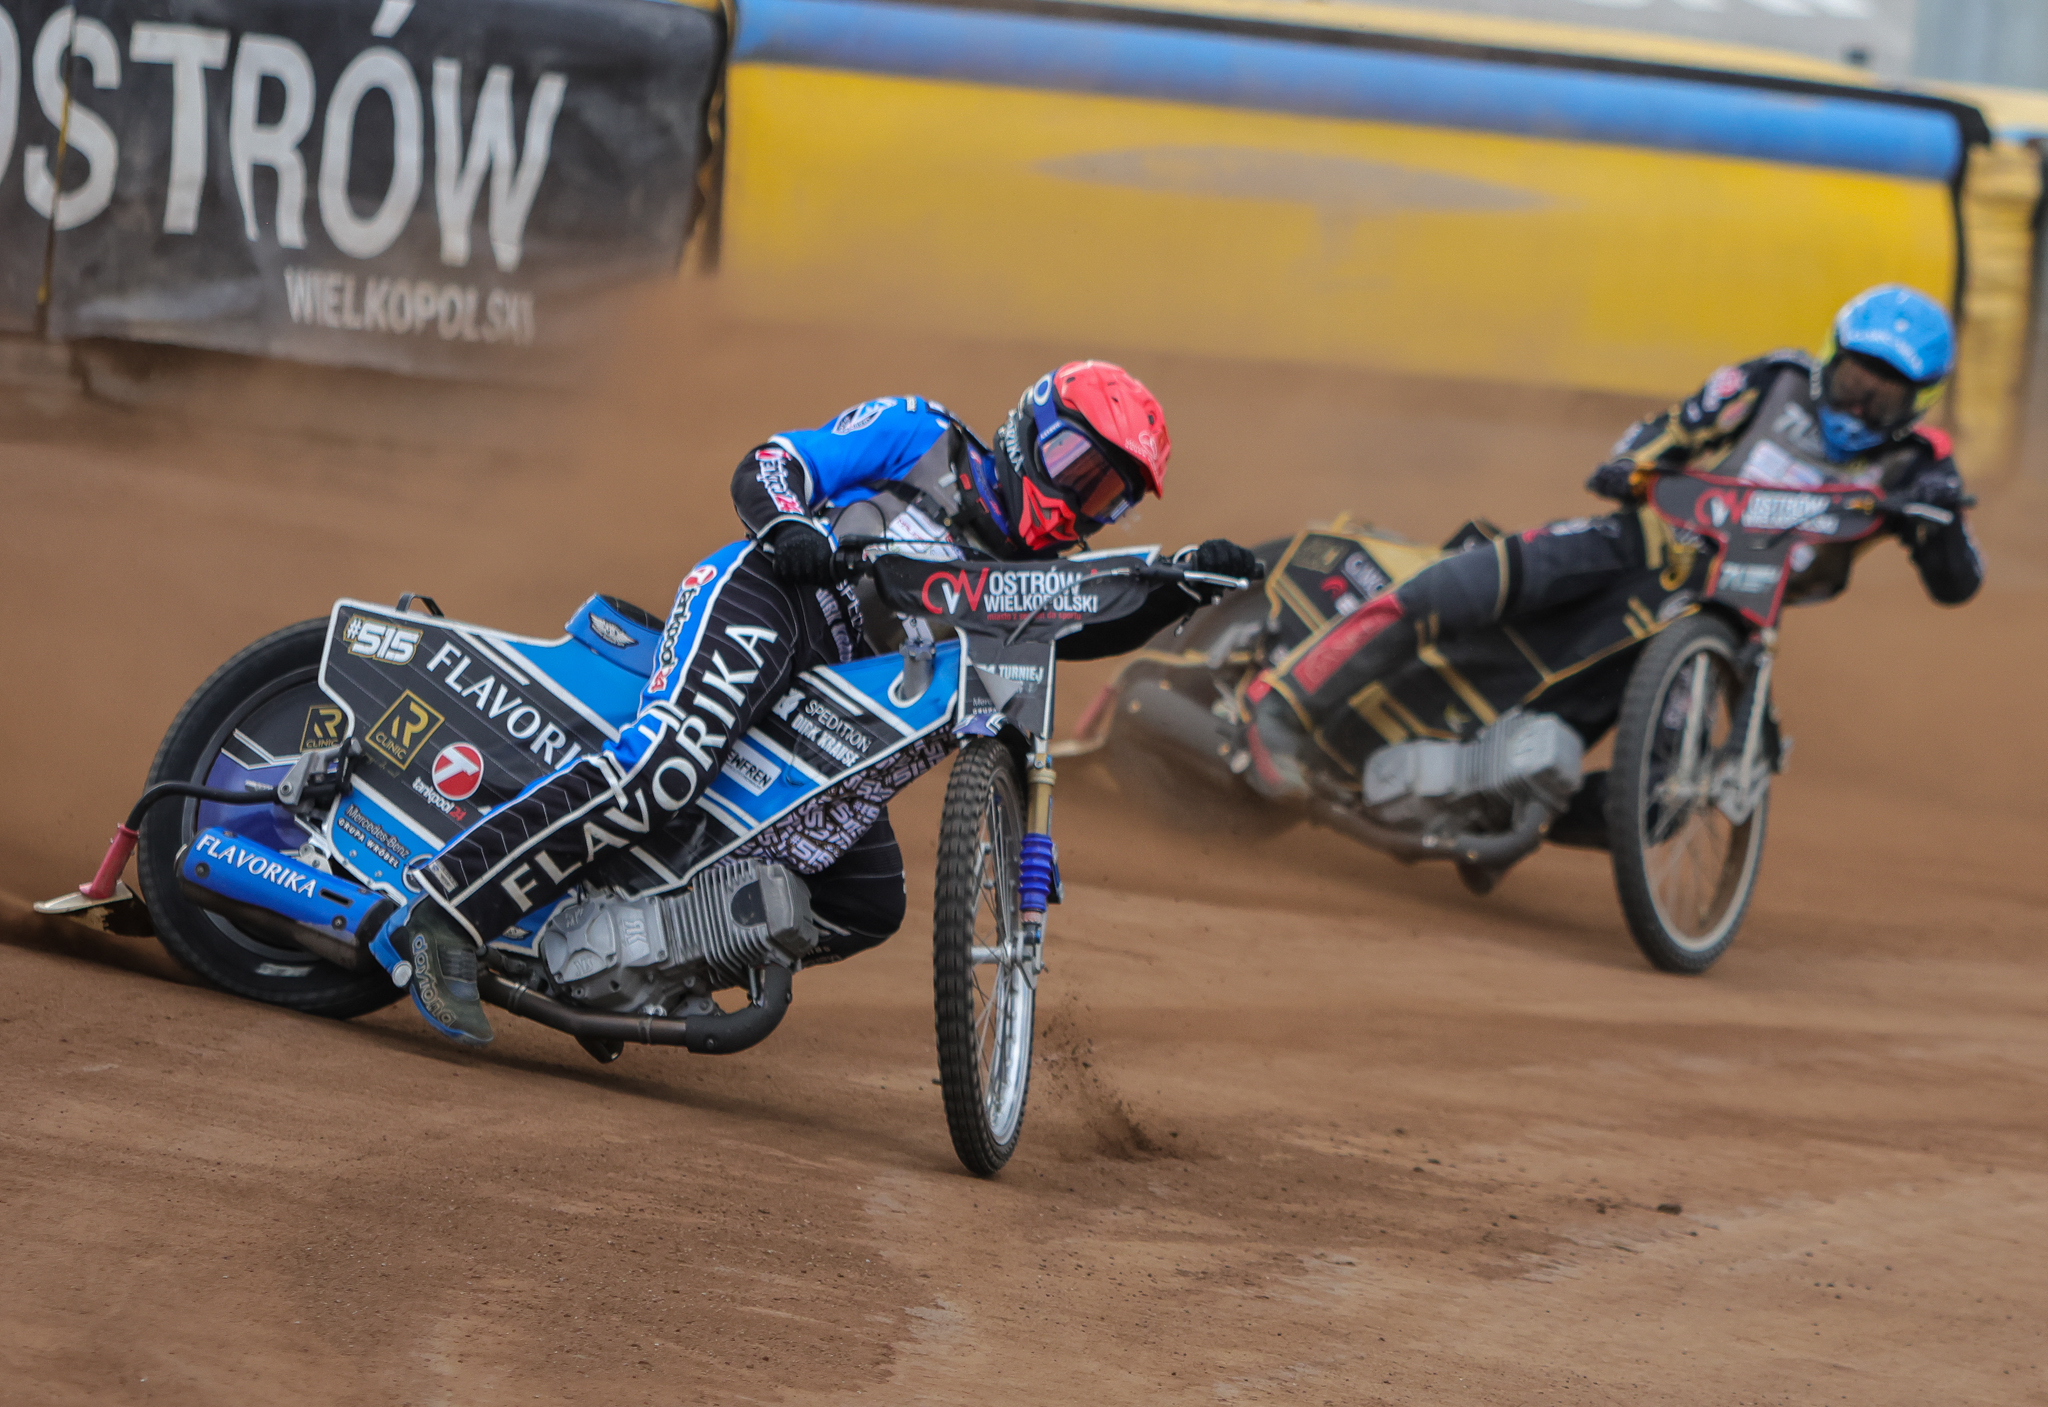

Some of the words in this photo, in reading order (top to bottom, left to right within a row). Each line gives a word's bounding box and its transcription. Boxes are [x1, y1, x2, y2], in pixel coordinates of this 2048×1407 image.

[0, 0, 567, 272] STRÓW
[285, 266, 536, 346] WIELKOPOLSKI
[988, 564, 1084, 597] OSTRÓW
[346, 617, 421, 663] #515
[998, 663, 1045, 685] TURNIEJ
[426, 640, 582, 771] FLAVORI
[804, 699, 873, 754] SPEDITION
[375, 731, 408, 761] CLINIC
[500, 624, 779, 913] FLAVORIKA
[790, 712, 822, 743] DIRK
[816, 731, 861, 769] KRAUSE
[725, 751, 773, 788] EWFREN
[412, 776, 467, 822] tankpool24
[337, 817, 366, 843] GRUPA
[344, 803, 412, 860] Mercedes-Benz
[195, 833, 318, 899] FLAVORIKA
[411, 933, 458, 1028] daytona
